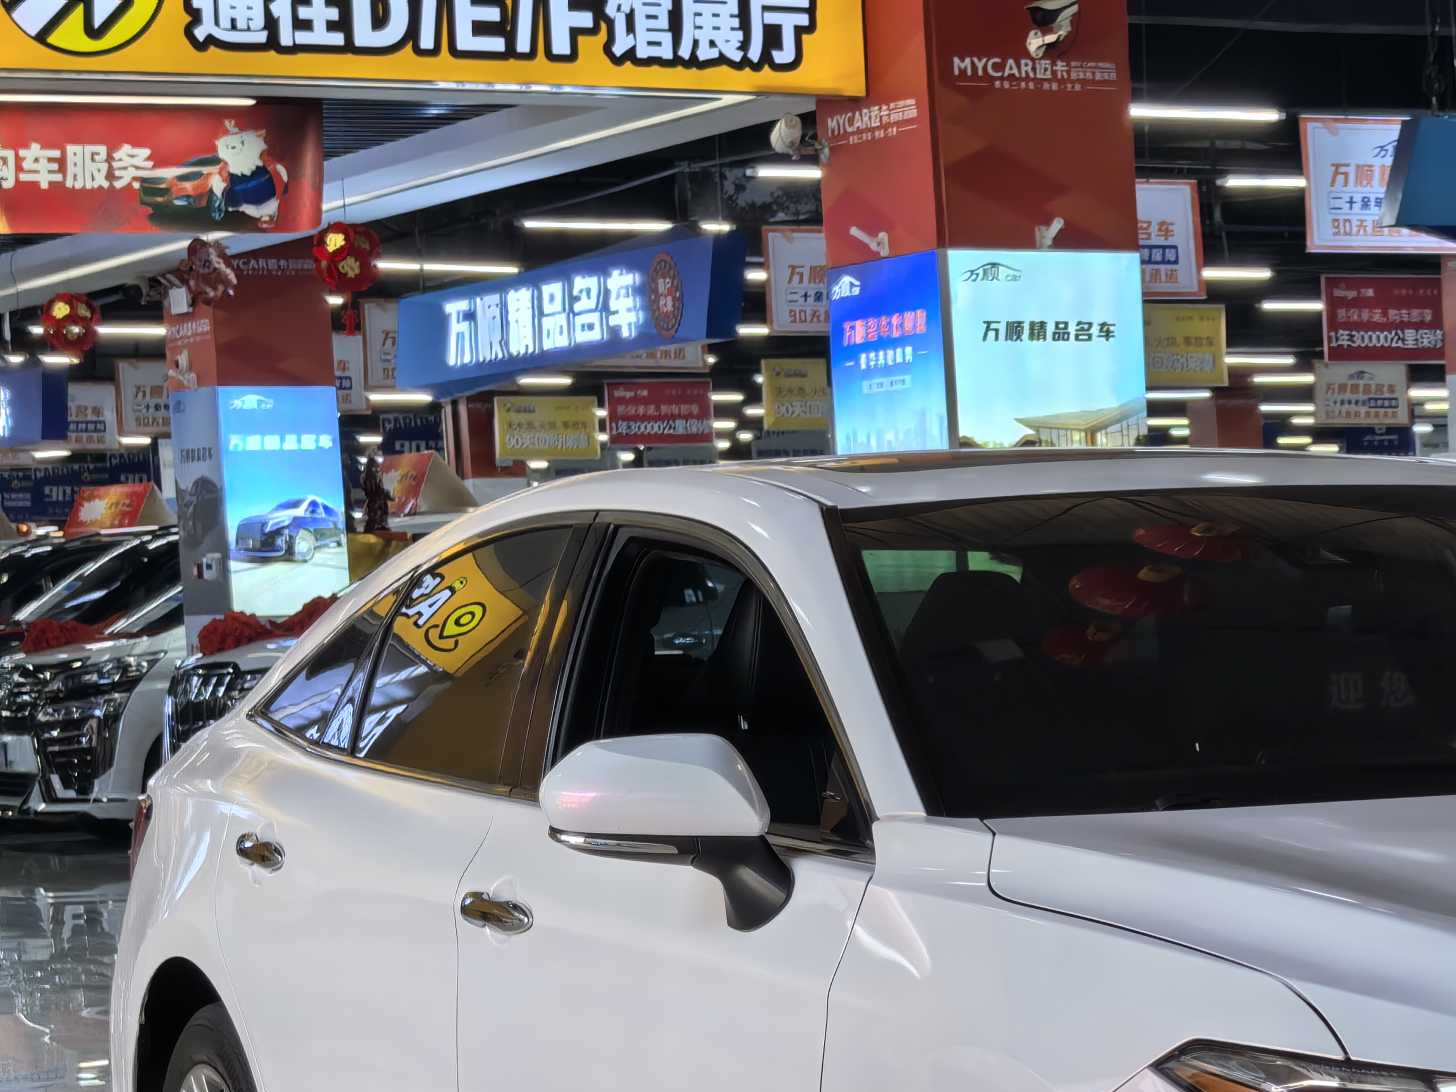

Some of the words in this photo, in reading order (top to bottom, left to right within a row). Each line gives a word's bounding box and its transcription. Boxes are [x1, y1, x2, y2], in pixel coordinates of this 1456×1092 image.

[445, 268, 643, 366] 万顺精品名车
[981, 320, 1117, 343] 万顺精品名车
